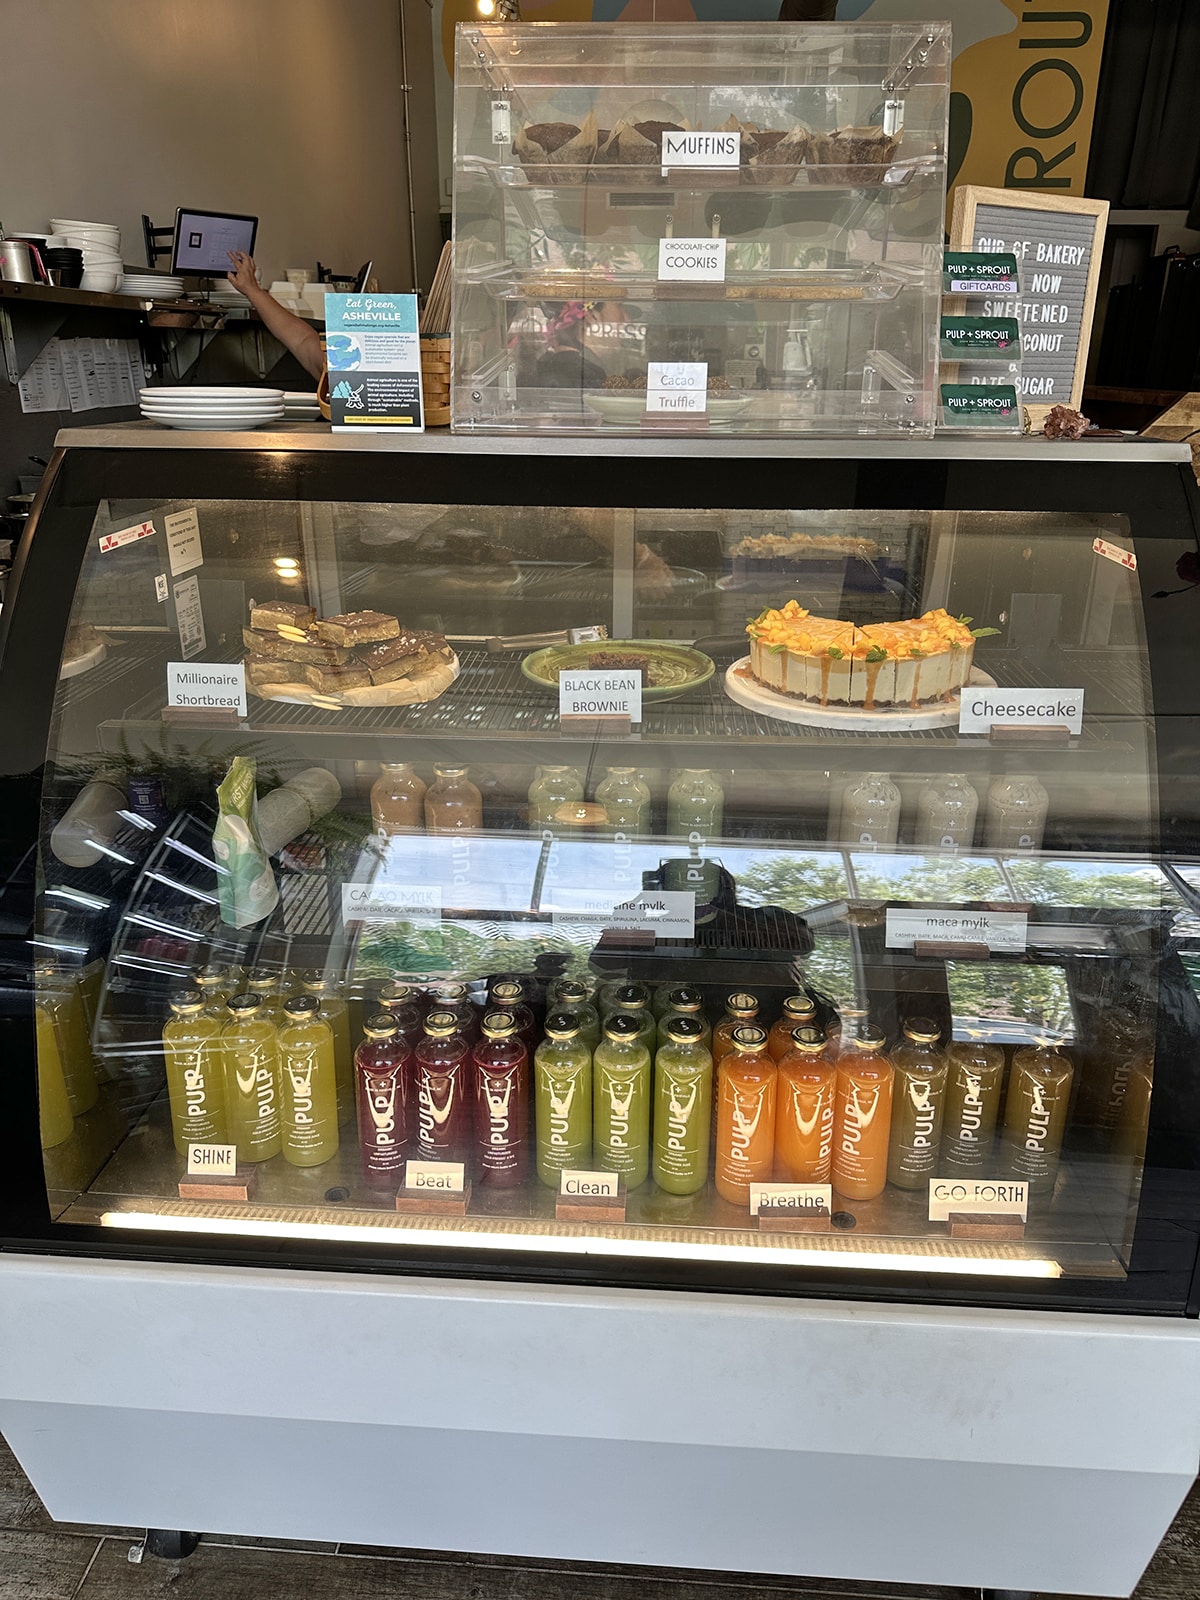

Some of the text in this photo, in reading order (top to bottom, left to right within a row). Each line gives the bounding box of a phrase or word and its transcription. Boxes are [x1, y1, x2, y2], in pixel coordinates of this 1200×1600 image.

[1004, 0, 1093, 187] ROU
[667, 137, 735, 155] MUFFINS
[664, 243, 720, 251] CHOCOLATE-CHIP
[1012, 241, 1031, 260] GF
[1036, 243, 1085, 266] BAKERY
[665, 256, 718, 269] COOKIES
[948, 265, 967, 274] PULP
[976, 265, 1011, 275] SPROUT
[960, 282, 1011, 291] GIFTCARDS
[1031, 273, 1062, 294] NOW
[345, 298, 397, 311] Eat Green,
[982, 301, 1068, 323] SWEETENED
[342, 312, 401, 321] ASHEVILLE
[946, 330, 965, 339] PULP
[975, 330, 1009, 340] SPROUT
[1019, 332, 1064, 352] CONUT
[660, 374, 695, 386] Cacao
[1013, 378, 1055, 395] SUGAR
[659, 396, 695, 407] Truffle
[948, 398, 968, 407] PULP
[976, 399, 1011, 408] SPROUT
[176, 673, 238, 686] Millionaire
[564, 680, 636, 692] BLACK BEAN
[175, 693, 240, 707] Shortbread
[572, 700, 629, 713] BROWNIE
[971, 700, 1076, 719] Cheesecake
[687, 831, 706, 881] PULP
[927, 918, 958, 927] maca
[256, 1069, 276, 1118] PULP
[419, 1090, 435, 1143] PULP
[913, 1100, 936, 1148] PULP
[959, 1093, 983, 1142] PULP
[819, 1107, 834, 1158] PULP
[842, 1103, 862, 1155] PULP
[1025, 1103, 1051, 1152] PULP
[193, 1148, 232, 1166] SHINE
[416, 1172, 452, 1188] Beat
[566, 1180, 611, 1195] Clean
[759, 1191, 825, 1209] Breathe
[934, 1185, 1024, 1203] GO FORTH
